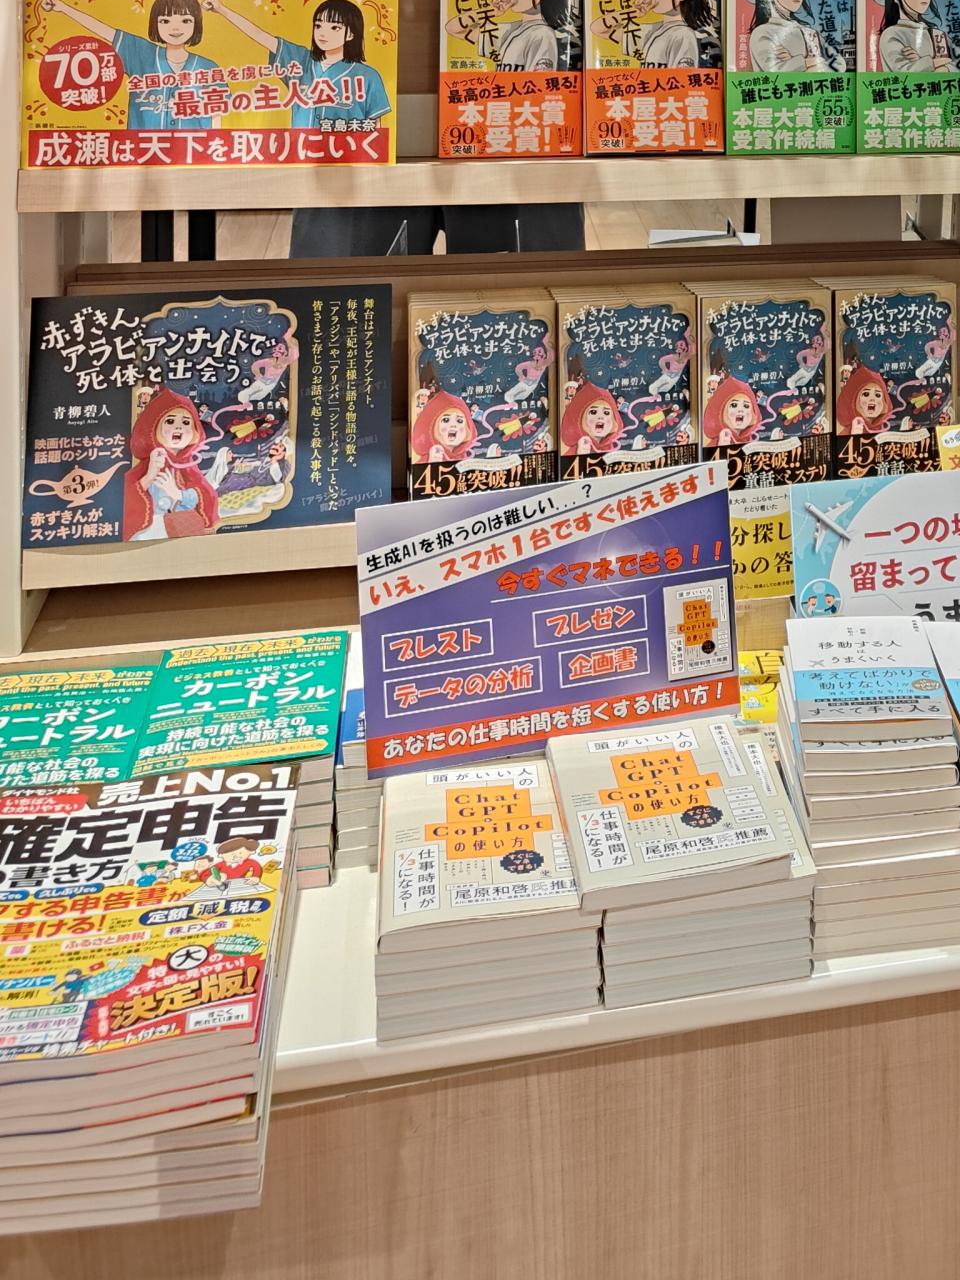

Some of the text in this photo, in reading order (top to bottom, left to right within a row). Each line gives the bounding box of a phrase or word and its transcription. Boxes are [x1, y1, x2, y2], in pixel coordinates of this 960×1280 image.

[58, 42, 99, 52] シリーズ累計
[127, 60, 303, 93] 全国の書店員を虜にした
[447, 74, 578, 105] 最高の主人公、現る!
[451, 75, 491, 88] かつてなく
[61, 87, 108, 107] 突破!
[172, 76, 367, 120] 最高の主人公!!
[741, 76, 851, 105] 誰にも予測不能!
[457, 100, 566, 126] 本屋大賞
[605, 96, 709, 121] 本屋大賞
[732, 106, 814, 128] 本屋大賞
[863, 107, 943, 128] 本屋大賞
[319, 118, 377, 133] 宮島未奈
[632, 121, 696, 149] 受賞!
[35, 130, 382, 166] 成瀬は天下を取りにいく
[485, 125, 551, 155] 受賞!
[732, 128, 837, 151] 受賞作続編
[40, 305, 148, 353] 赤ずきん、
[425, 321, 545, 349] アラビアンナイトで
[573, 315, 686, 343] アラビアンナイトで
[59, 325, 278, 373] アラビアンナイトで
[363, 297, 376, 409] 舞台はアラビアンナイト。
[76, 356, 251, 395] 死体と出会う。
[345, 298, 358, 469] 毎夜、王妃が王様に語る物語の数々。
[309, 300, 323, 487] 皆さまご存じのお話で起こる殺人事件。
[52, 403, 112, 421] 青柳碧人
[34, 433, 126, 451] 映画化にもなった
[34, 446, 124, 465] 話題のシリーズ
[63, 474, 100, 496] 第3弾!
[413, 464, 522, 497] 45万部突破!!
[743, 464, 828, 488] 童話×ミステリ
[30, 507, 104, 527] 赤ずきんが
[29, 521, 120, 542] スッキリ解決!
[368, 466, 717, 607] いえ、スマホ1台ですぐ使えます!
[731, 521, 793, 547] 分探し
[495, 540, 724, 597] 今すぐマネできる!!
[545, 604, 636, 638] プレゼン
[166, 654, 218, 668] Understand
[218, 653, 233, 662] the
[296, 646, 312, 655] and
[313, 642, 341, 653] future
[177, 635, 342, 659] 過去 現在 未来 がわかる
[388, 629, 484, 662] ブレスト
[567, 646, 640, 680] 企画書
[831, 654, 897, 664] うまくいく
[181, 671, 314, 699] カーボン
[392, 663, 535, 710] データの分析
[149, 685, 336, 720] ニュートラル
[808, 704, 942, 716] すべて手に入る
[166, 716, 308, 743] 持続可能な社会の
[382, 681, 725, 760] あなたの仕事時間を短くする使い方!
[138, 724, 330, 759] 実現に向けた道筋を探る
[593, 730, 694, 751] 頭がいい人の
[620, 754, 685, 770] Chat
[627, 765, 684, 782] GPT
[2, 786, 81, 797] ダイヤモンド社
[97, 765, 293, 808] 売上No.1
[454, 791, 521, 806] Chat
[607, 777, 714, 801] Copilot
[2, 801, 80, 815] わかりやすい
[5, 795, 56, 806] いちばん
[458, 803, 519, 818] GPT
[632, 793, 700, 813] の使い方
[432, 820, 544, 838] Copilot
[600, 809, 628, 866] 仕事時間が
[645, 828, 770, 856] 尾原和啓氏推薦
[418, 849, 436, 909] 仕事時間が
[2, 915, 106, 941] 書ける!
[64, 930, 147, 950] ふるさと納税
[110, 965, 258, 1032] 決定版!
